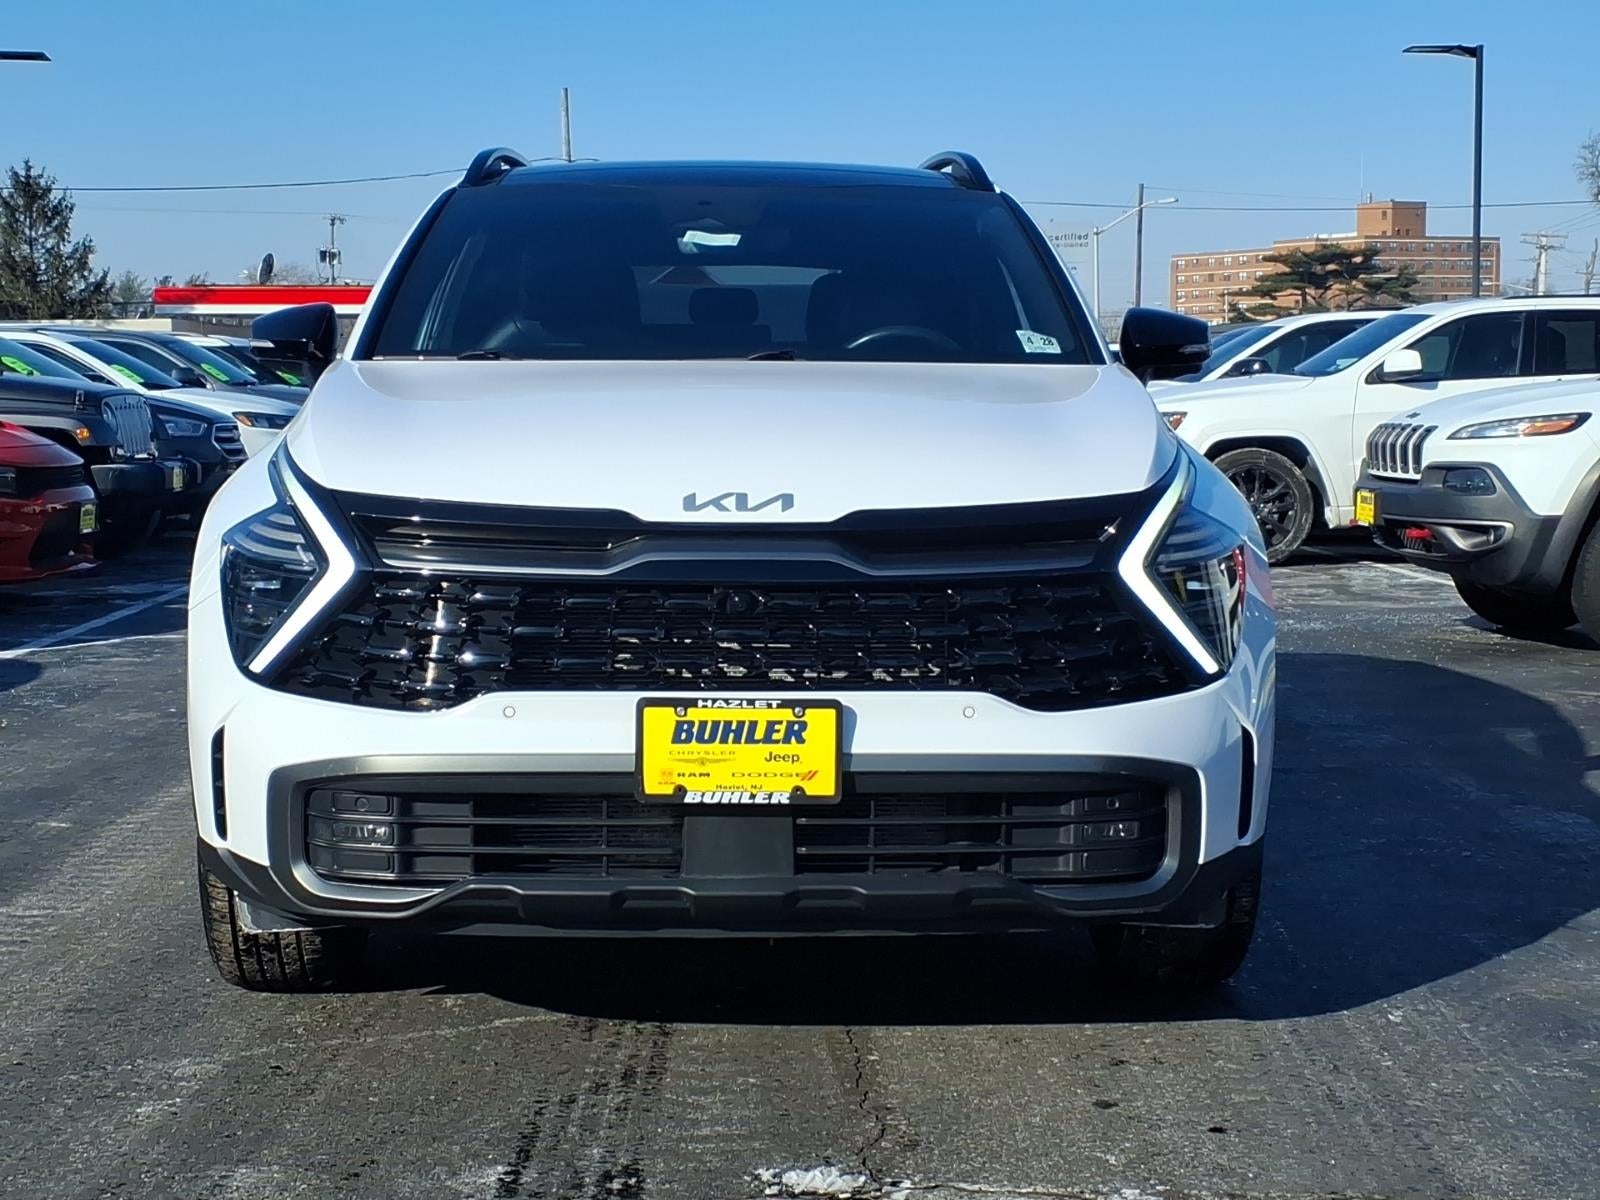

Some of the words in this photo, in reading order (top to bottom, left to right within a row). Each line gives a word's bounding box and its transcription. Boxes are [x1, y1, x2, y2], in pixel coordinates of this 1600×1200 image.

[682, 492, 795, 513] KIA
[697, 699, 782, 709] HAZLET
[671, 719, 808, 745] BUHLER
[764, 751, 801, 765] Jeep
[683, 791, 791, 804] BUHLER
